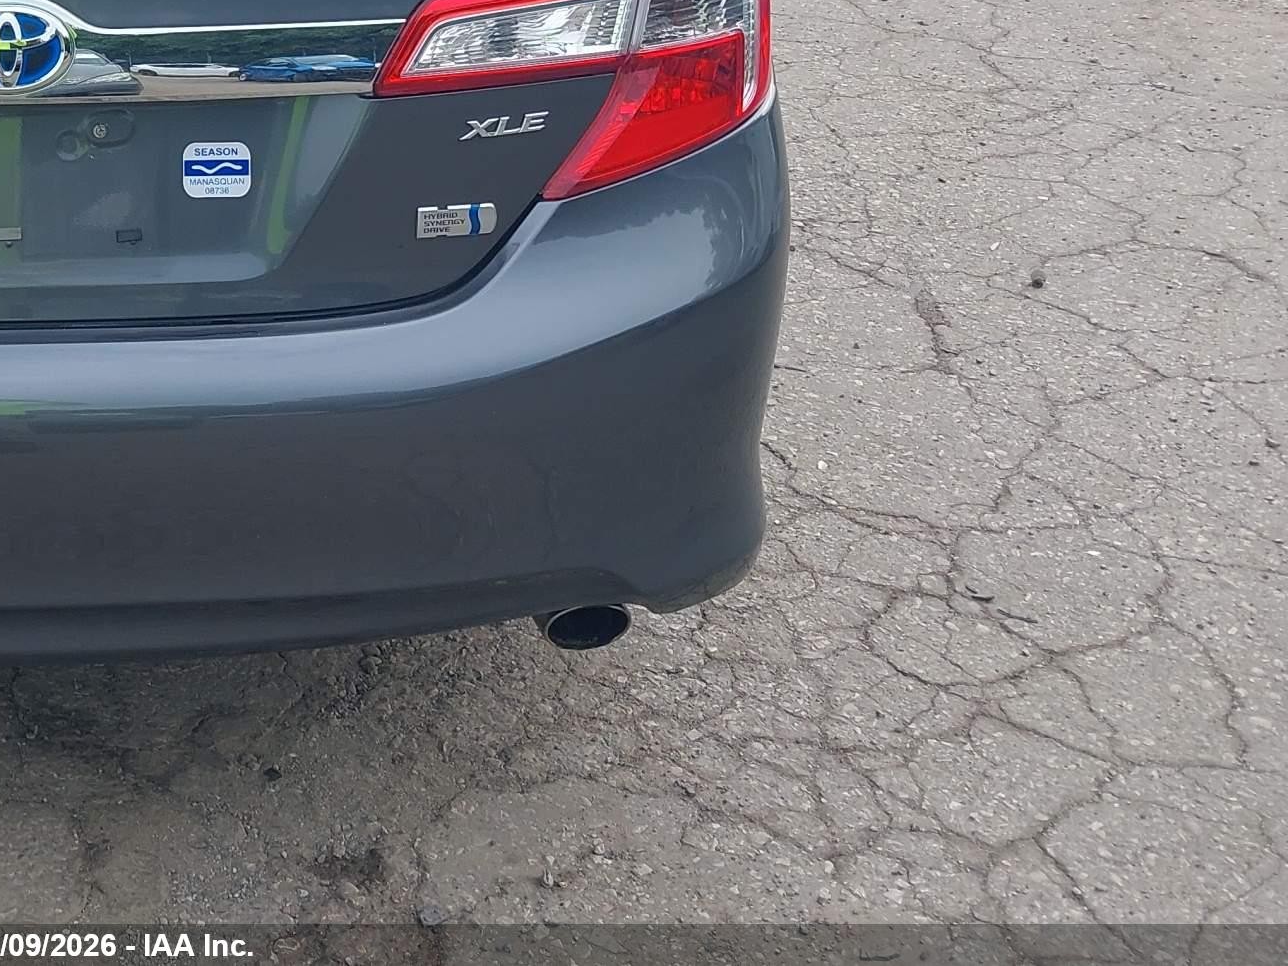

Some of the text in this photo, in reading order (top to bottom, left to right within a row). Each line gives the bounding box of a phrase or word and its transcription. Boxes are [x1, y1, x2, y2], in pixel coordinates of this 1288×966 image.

[458, 111, 549, 141] XLE
[194, 147, 239, 156] SEASON
[189, 177, 245, 186] MANASQUAN
[423, 211, 458, 220] HYBRID
[423, 218, 466, 228] SYNERGY
[423, 226, 452, 234] DRIVE
